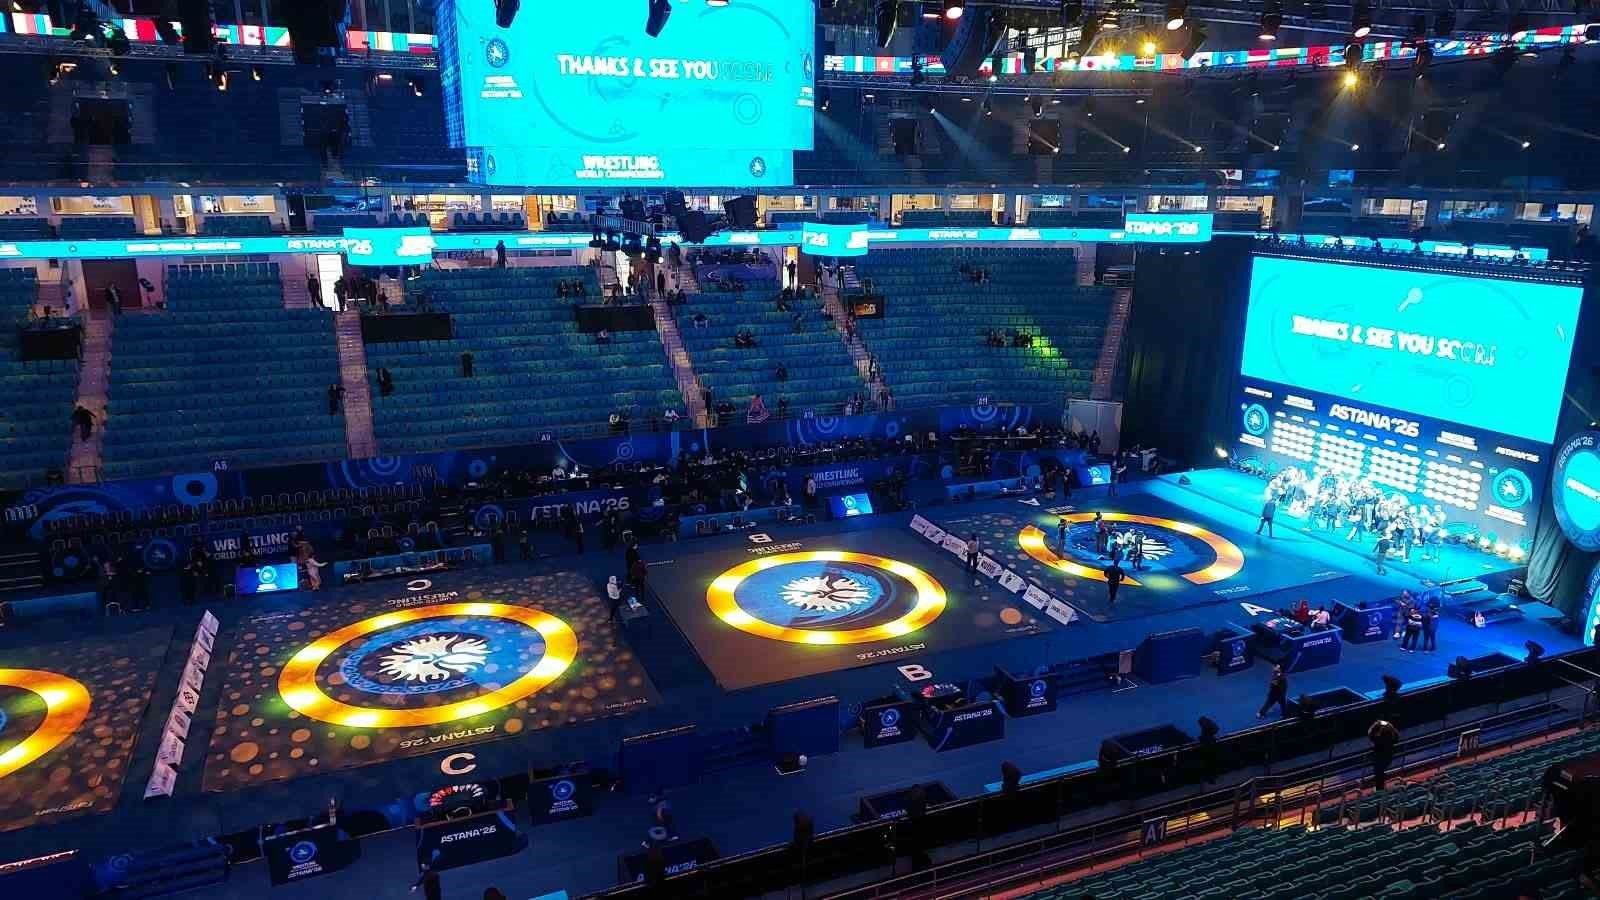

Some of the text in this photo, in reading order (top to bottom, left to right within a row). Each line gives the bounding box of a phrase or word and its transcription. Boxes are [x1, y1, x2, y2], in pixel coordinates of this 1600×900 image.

[557, 54, 628, 76] THANKS
[633, 57, 647, 77] &
[649, 58, 680, 78] SEE
[680, 60, 718, 80] YOU
[1365, 327, 1396, 349] SEE
[1397, 331, 1435, 355] YOU
[1329, 404, 1421, 438] ASTANA'26
[213, 532, 288, 552] WRTLING
[748, 533, 772, 545] B
[407, 579, 433, 591] C
[1240, 601, 1274, 617] A
[856, 642, 926, 660] ASTANA'26
[897, 664, 932, 681] B
[399, 725, 496, 748] ASTANA'26
[440, 752, 476, 775] C
[441, 825, 497, 843] ASTANA'26
